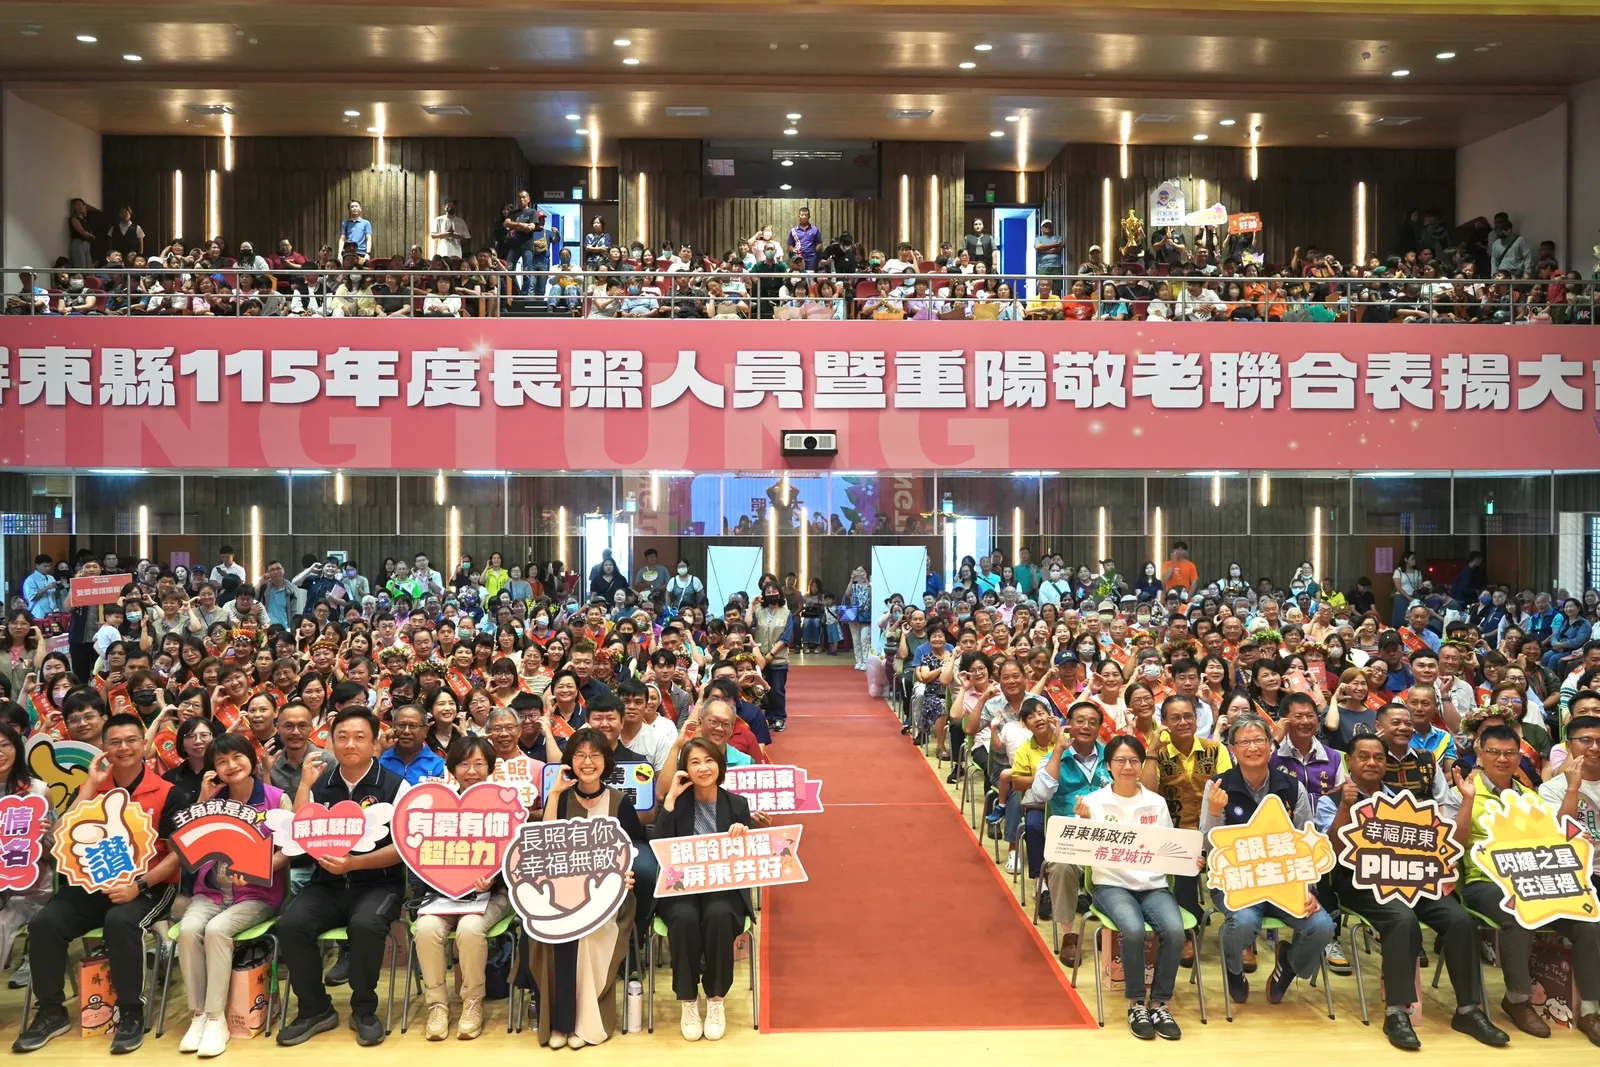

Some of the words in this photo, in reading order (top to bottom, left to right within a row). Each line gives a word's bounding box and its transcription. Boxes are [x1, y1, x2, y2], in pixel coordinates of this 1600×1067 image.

[0, 346, 1600, 411] 東縣115年度長照人員暨重陽敬老聯合表揚大
[0, 806, 34, 836] 情
[173, 800, 257, 829] 主角就是我
[408, 811, 510, 838] 有愛有你
[520, 821, 615, 853] 長照有你
[669, 833, 771, 865] 銀齡閃耀
[1060, 824, 1137, 845] 屏東縣政府
[1234, 831, 1297, 863] 銀髮
[1366, 821, 1435, 848] 幸福屏東
[0, 838, 31, 868] 名
[419, 840, 496, 866] 超給力
[521, 847, 617, 878] 幸福無敵
[1094, 845, 1155, 865] 希望城市
[1361, 854, 1438, 880] Plus+
[1495, 847, 1579, 874] 閃耀之星
[683, 856, 783, 889] 屏東共好
[1223, 855, 1318, 891] 新生活
[1515, 872, 1580, 897] 在這裡
